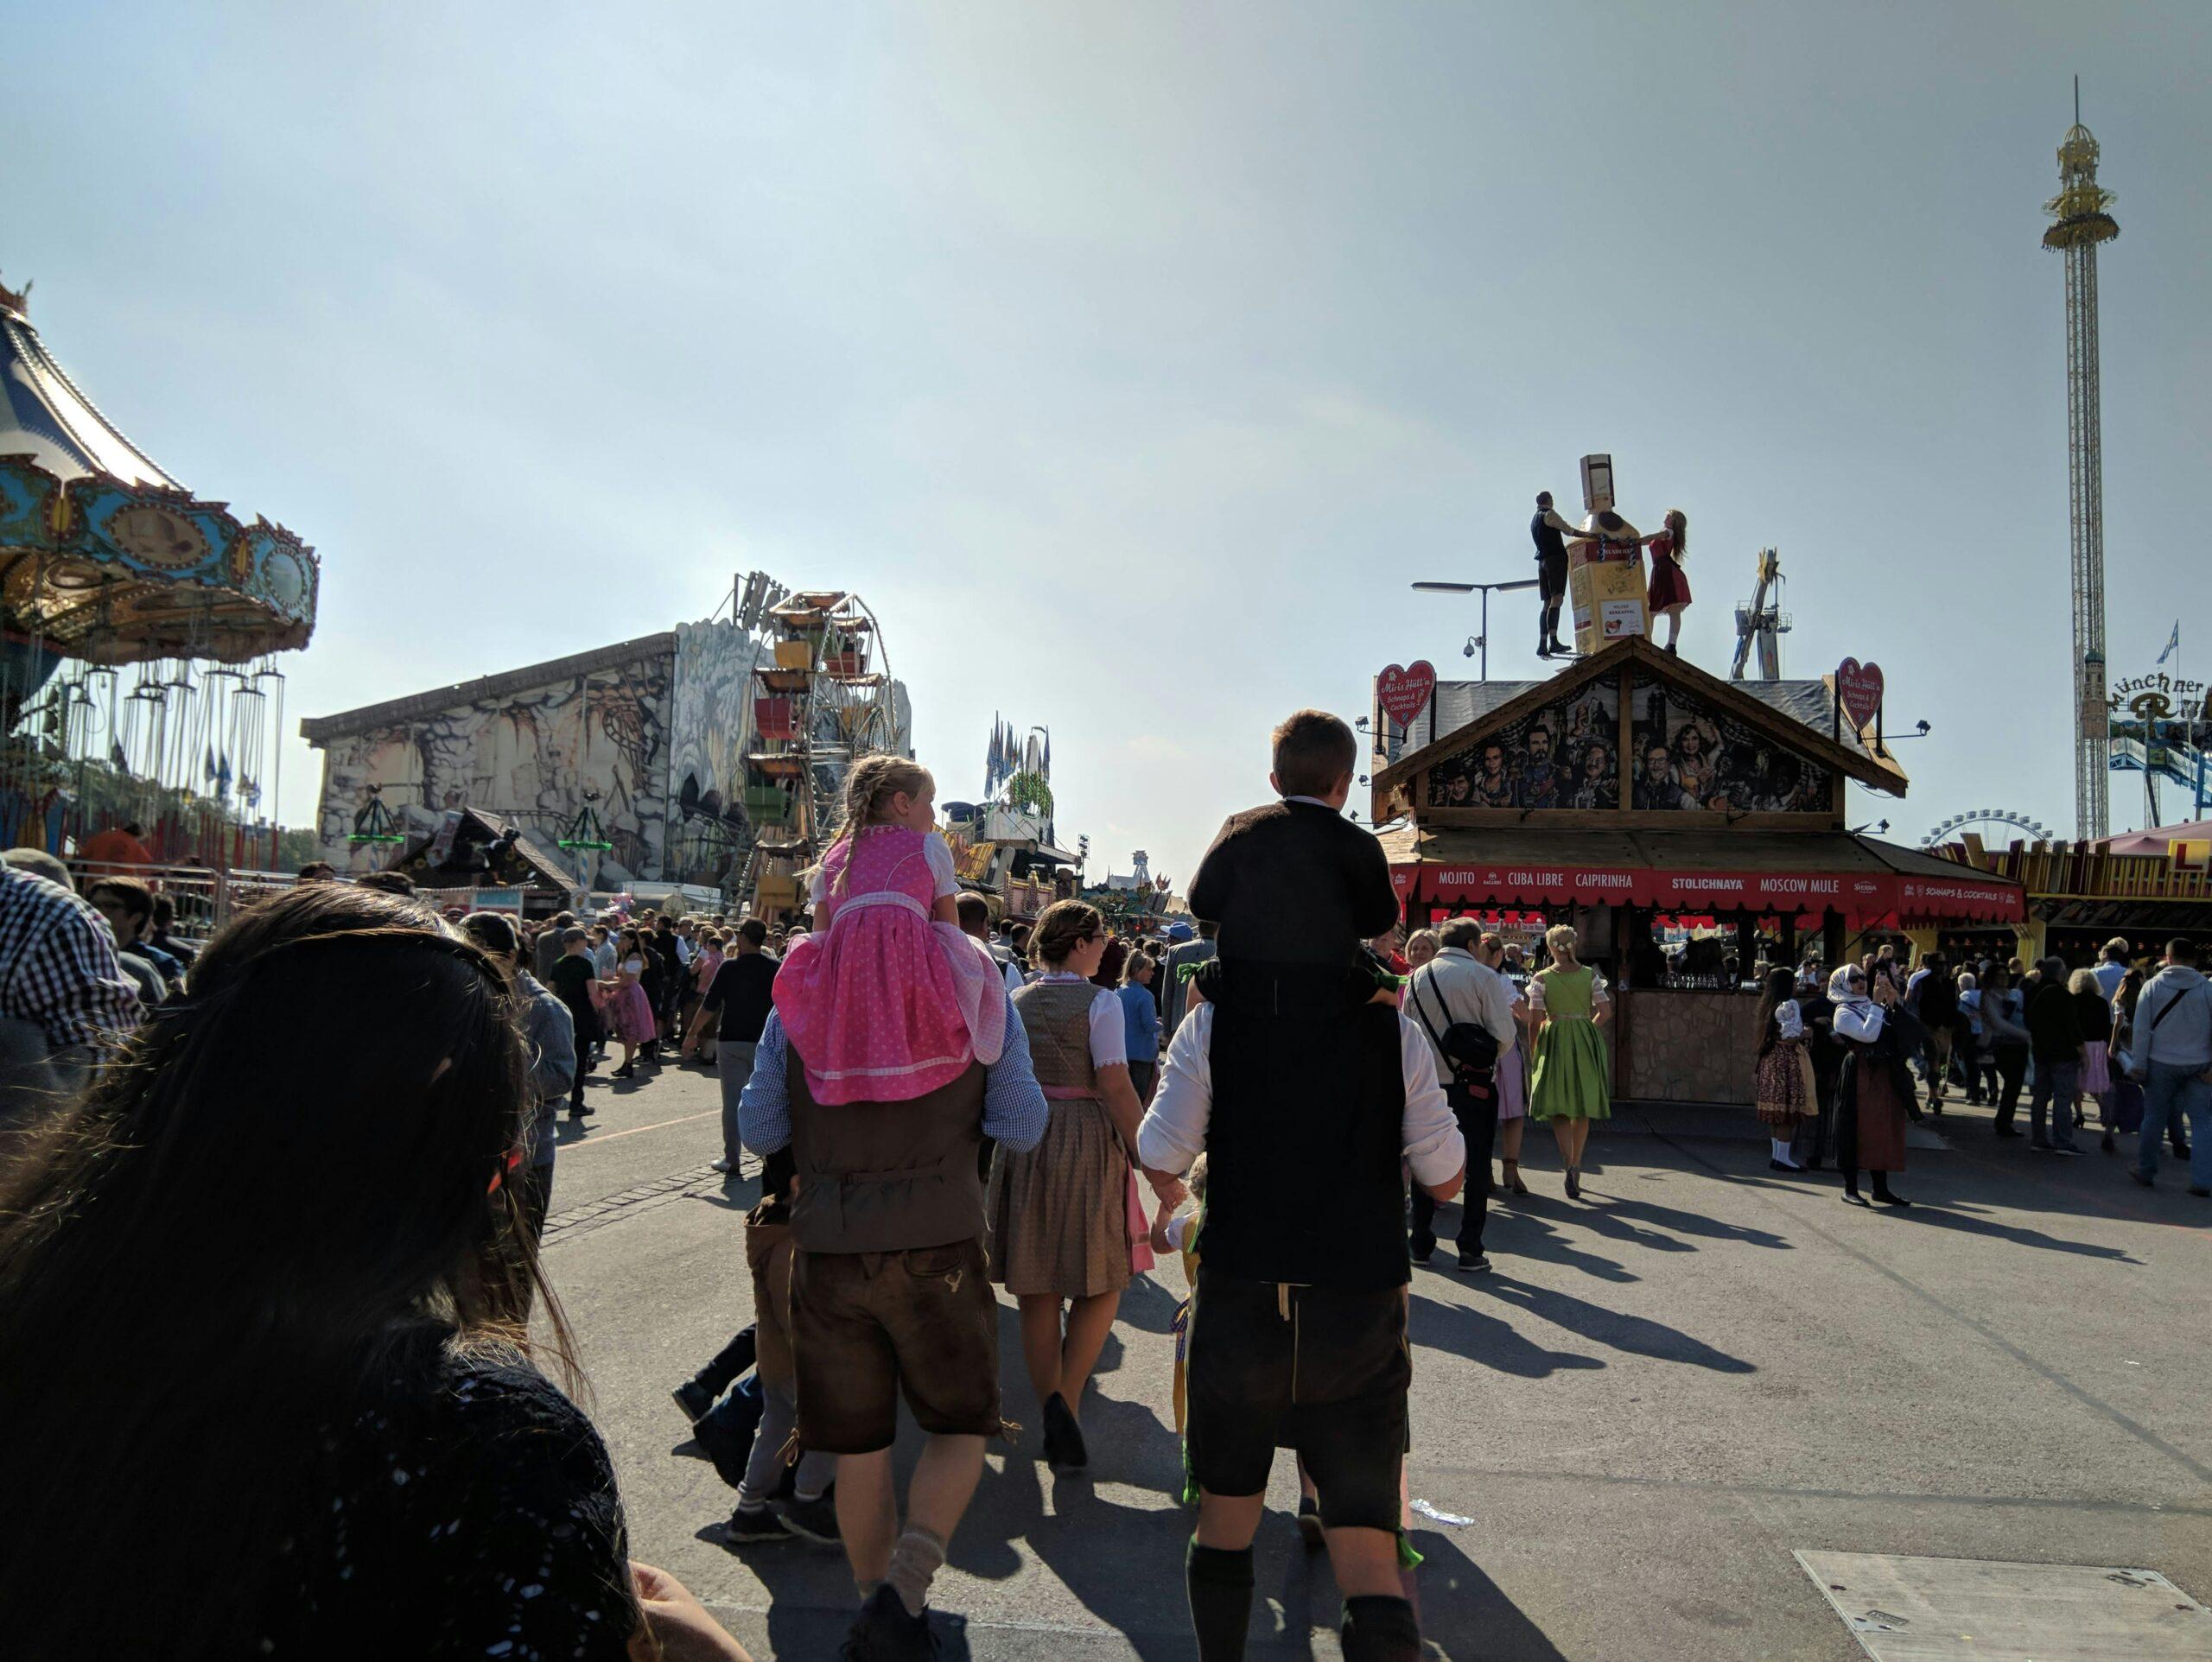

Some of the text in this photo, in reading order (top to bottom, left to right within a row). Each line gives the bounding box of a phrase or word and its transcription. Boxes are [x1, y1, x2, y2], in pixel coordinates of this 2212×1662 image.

[2107, 672, 2204, 713] Münchner
[1390, 701, 1415, 711] Cocktails
[2175, 843, 2203, 871] L
[1439, 872, 1475, 885] MOJITO
[1508, 872, 1564, 887] CUBA LIBRE
[1575, 873, 1633, 888] CAIPIRINHA
[1672, 878, 1744, 891] STOLICHNAYA
[1760, 878, 1840, 893] MOSCOW MULE
[1925, 886, 1955, 898] SCHNAPS
[1956, 889, 1963, 898] &
[1963, 891, 1998, 901] COCKTAILS
